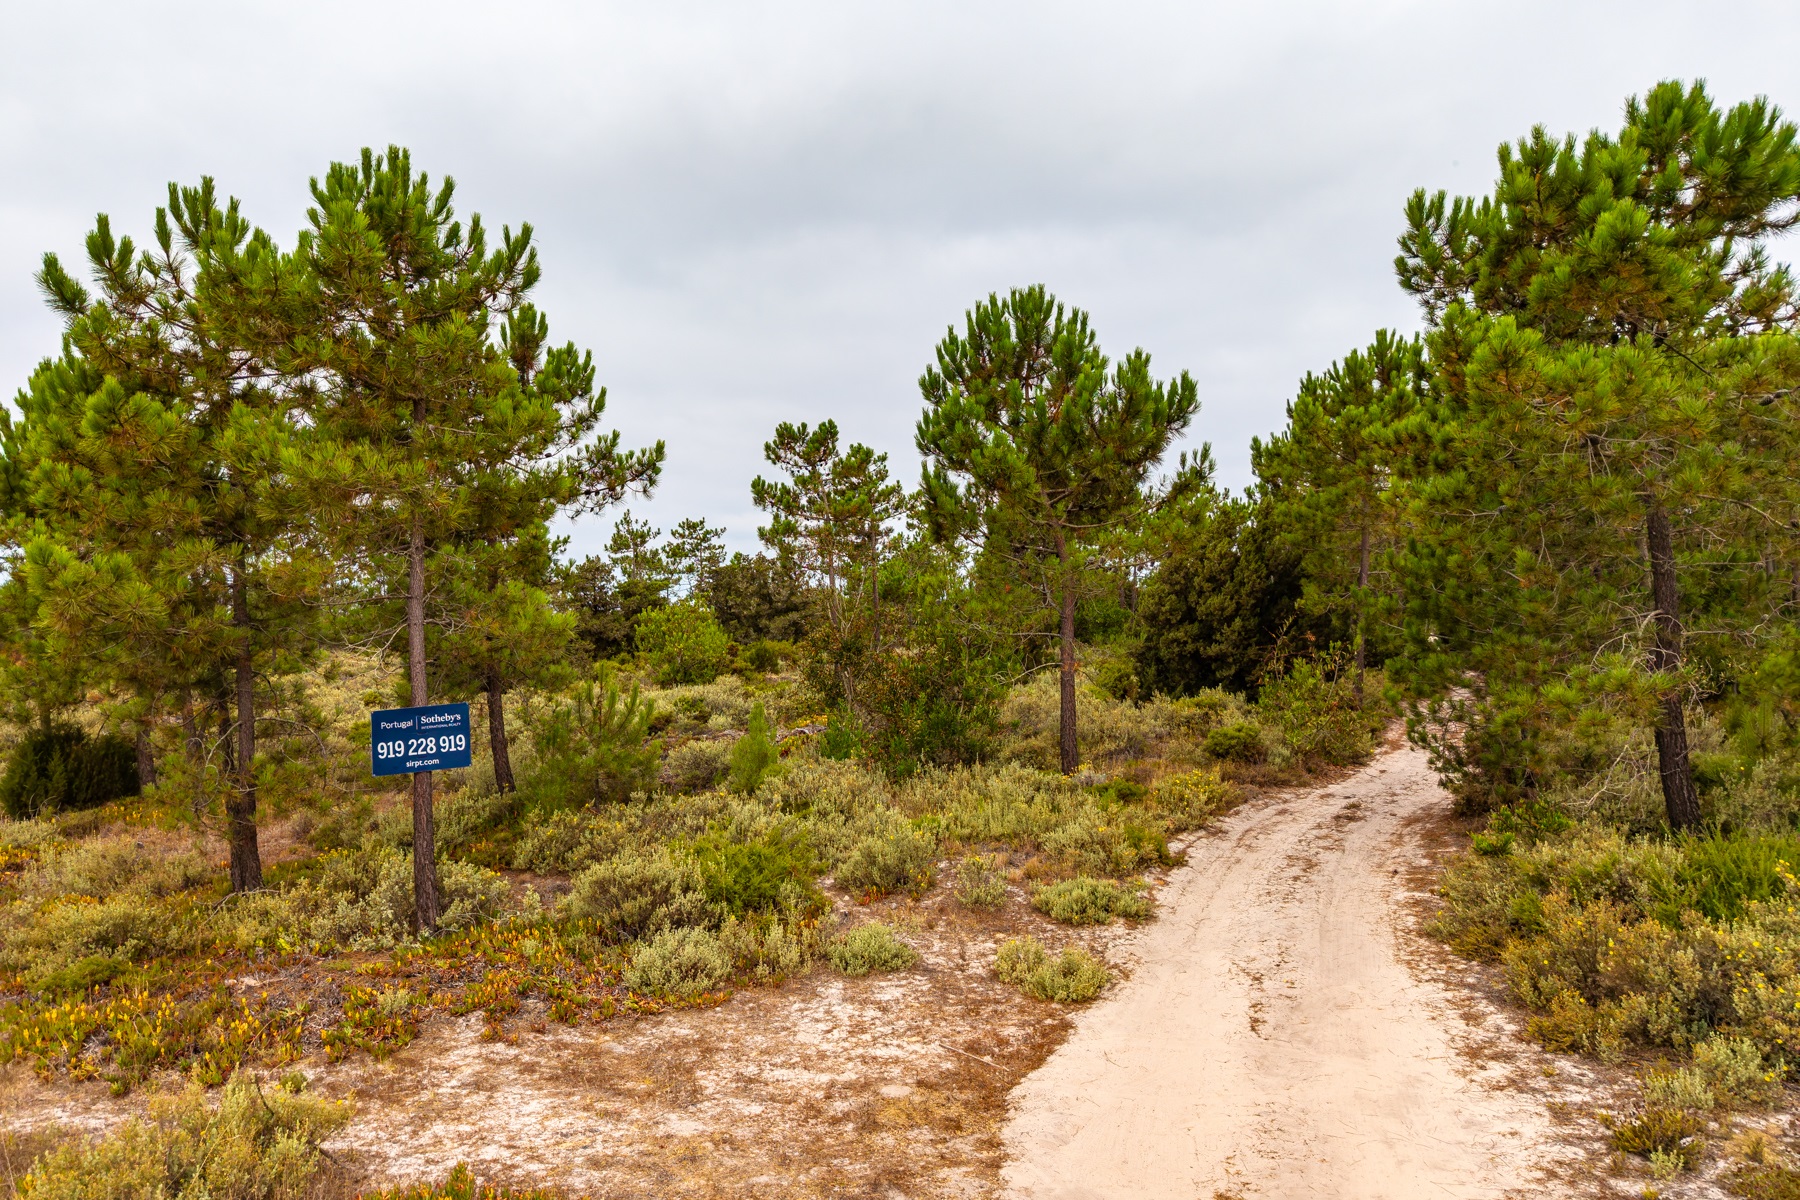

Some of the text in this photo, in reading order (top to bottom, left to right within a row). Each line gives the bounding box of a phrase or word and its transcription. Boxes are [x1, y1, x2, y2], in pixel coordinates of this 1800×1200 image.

[421, 713, 461, 724] Sotheby's
[381, 720, 413, 729] Portugal
[377, 734, 465, 759] 919 228 919
[406, 759, 439, 768] sirpt.com
